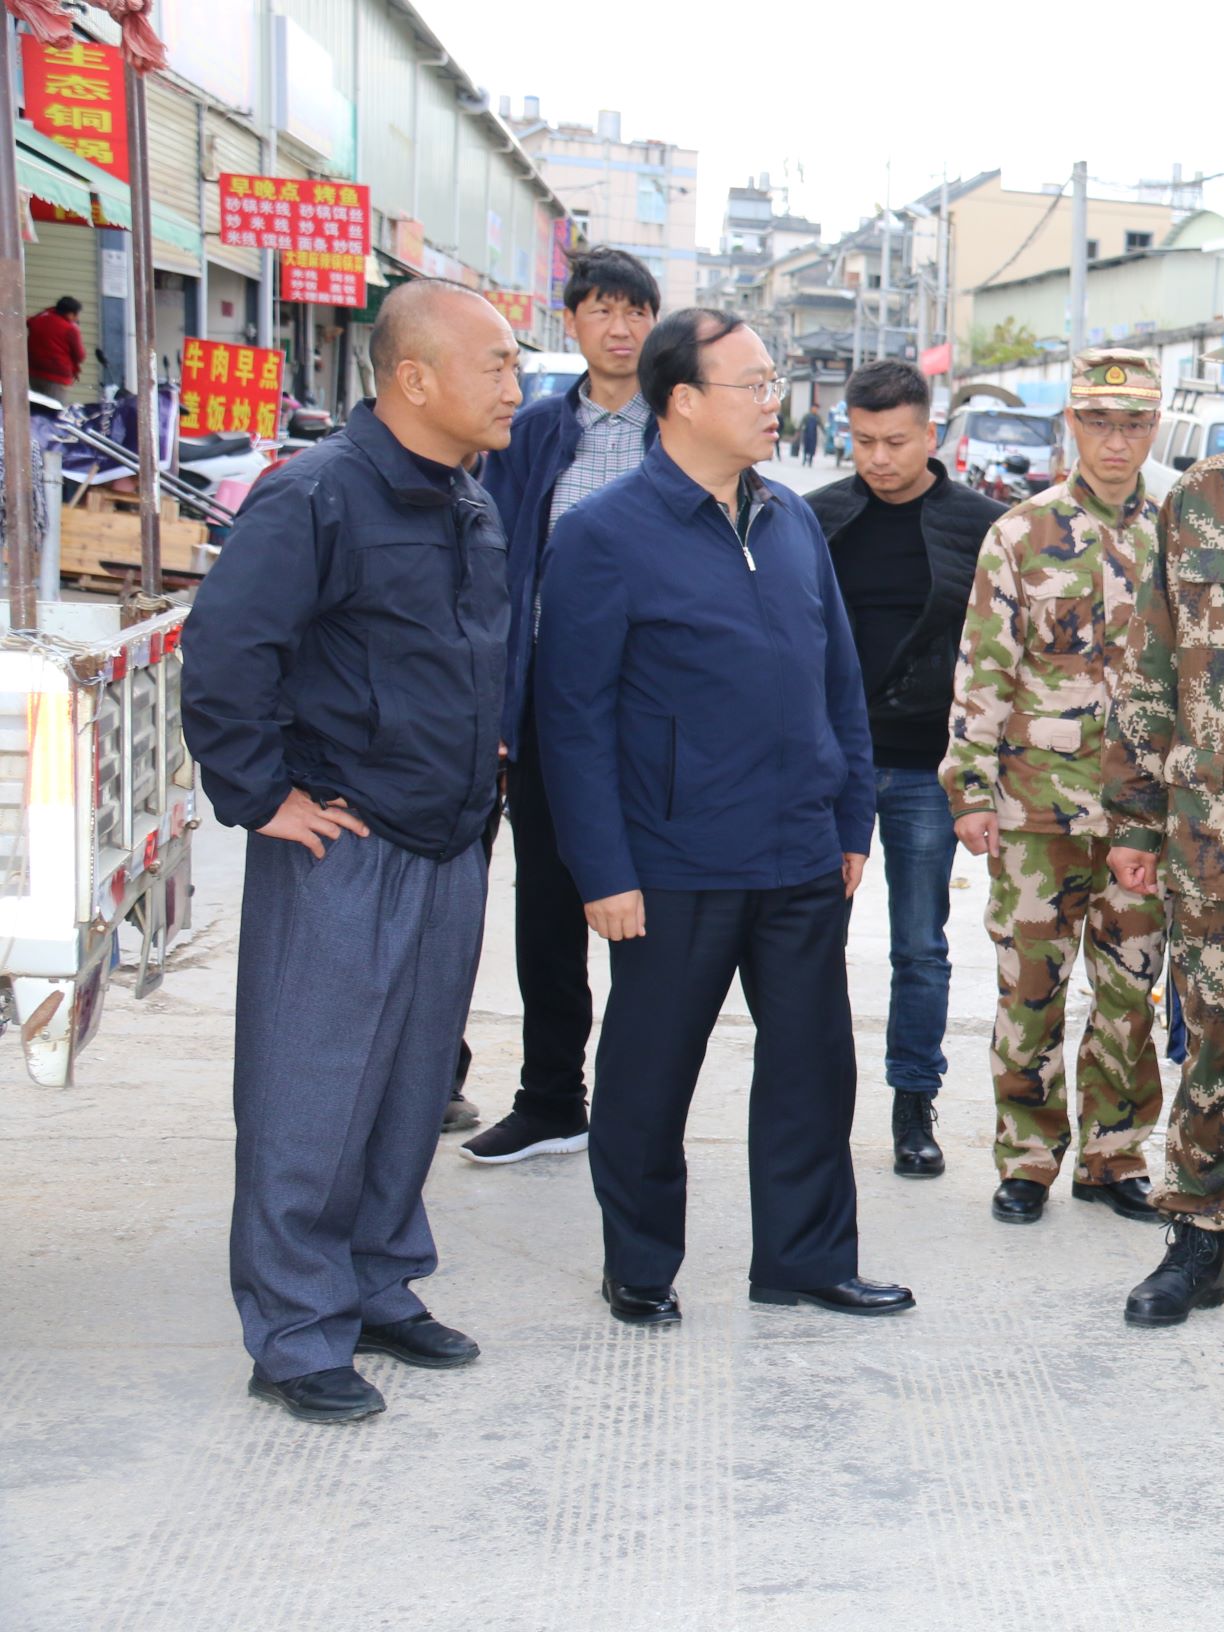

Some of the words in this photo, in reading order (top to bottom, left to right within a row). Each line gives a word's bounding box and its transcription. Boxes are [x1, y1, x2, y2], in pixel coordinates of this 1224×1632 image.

[230, 176, 300, 201] 早晚点
[313, 185, 359, 207] 烤鱼
[225, 197, 291, 217] 砂锅米线
[225, 213, 291, 233] 炒米线
[226, 231, 257, 247] 米线
[297, 236, 328, 252] 面条
[332, 239, 363, 254] 炒饭
[184, 341, 280, 390] 牛肉早点
[180, 391, 277, 440] 盖饭炒饭
